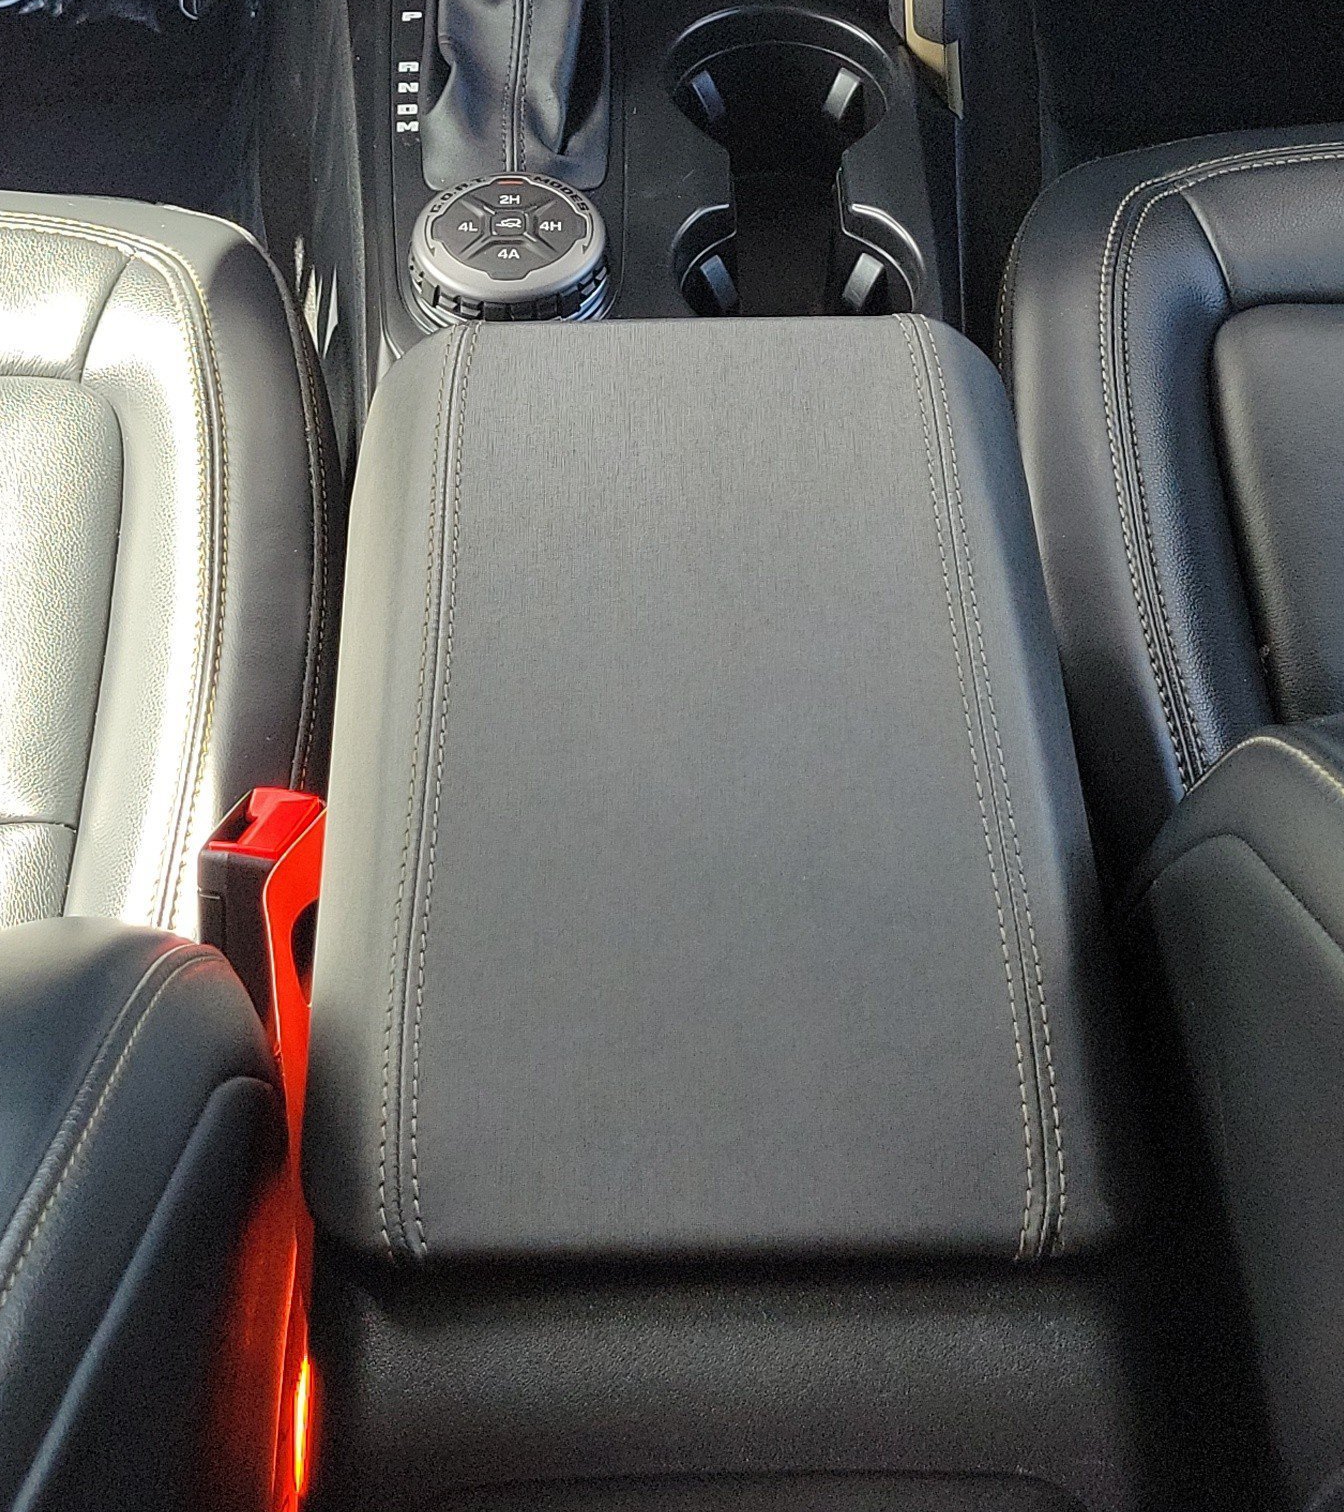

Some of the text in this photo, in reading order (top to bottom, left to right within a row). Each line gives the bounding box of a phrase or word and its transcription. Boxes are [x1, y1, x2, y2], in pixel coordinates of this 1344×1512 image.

[499, 194, 521, 205] 2H
[533, 176, 591, 212] MODES
[457, 221, 479, 232] 4L
[539, 221, 562, 232] 4H
[497, 248, 520, 259] 4A
